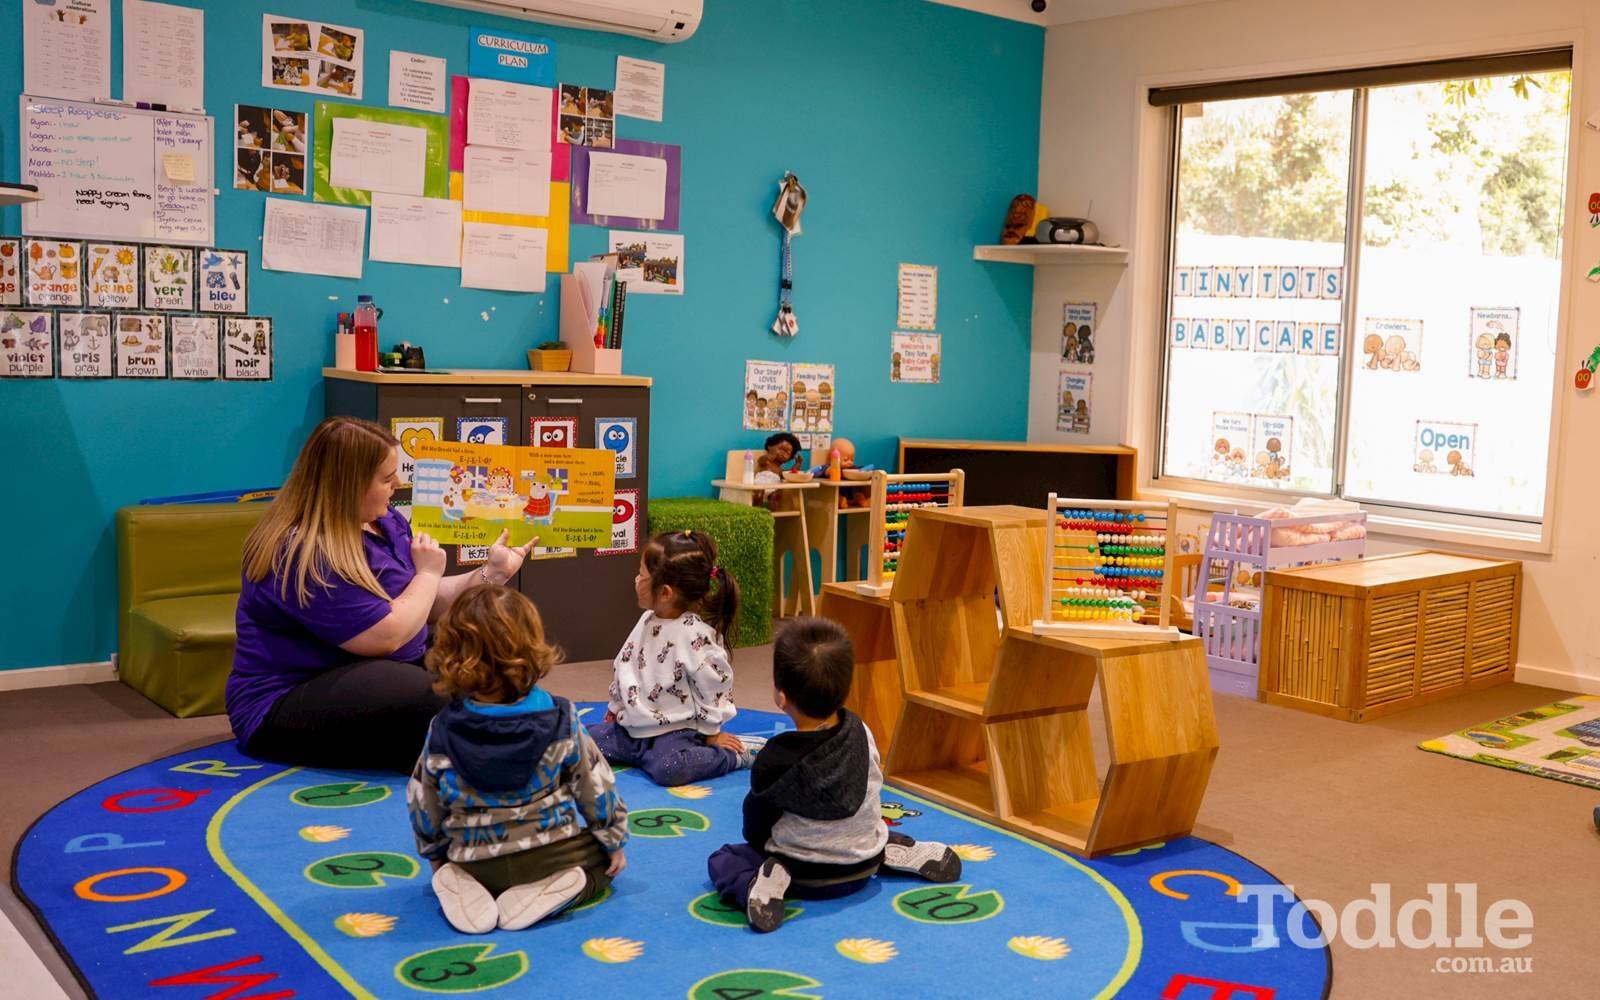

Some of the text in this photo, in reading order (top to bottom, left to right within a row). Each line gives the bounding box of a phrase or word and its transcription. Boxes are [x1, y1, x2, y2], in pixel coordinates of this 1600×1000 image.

[479, 36, 547, 53] CURRICULUM
[500, 56, 526, 66] PLAN
[76, 189, 102, 199] Nappy
[1180, 272, 1337, 293] TINY TOTS
[32, 283, 78, 295] orange
[154, 286, 184, 296] vert
[209, 291, 236, 301] bleu
[154, 297, 183, 308] green
[213, 301, 232, 310] blue
[1175, 323, 1336, 349] BABY CARE
[7, 352, 45, 363] violet
[73, 353, 100, 364] gris
[127, 356, 156, 365] brun
[235, 359, 260, 368] noir
[9, 363, 44, 374] purple
[75, 364, 99, 376] gray
[126, 366, 158, 375] brown
[184, 367, 208, 376] white
[236, 368, 260, 376] black
[796, 373, 816, 381] Feeding
[1421, 428, 1470, 451] Open
[168, 760, 263, 777] R
[101, 788, 212, 813] Q
[633, 815, 682, 828] 8
[64, 833, 166, 853] P
[325, 858, 386, 876] 2
[73, 867, 187, 902] O
[1149, 870, 1244, 900] C
[902, 892, 979, 920] 10
[106, 909, 236, 954] N
[1180, 921, 1278, 953] D
[411, 961, 477, 983] 3
